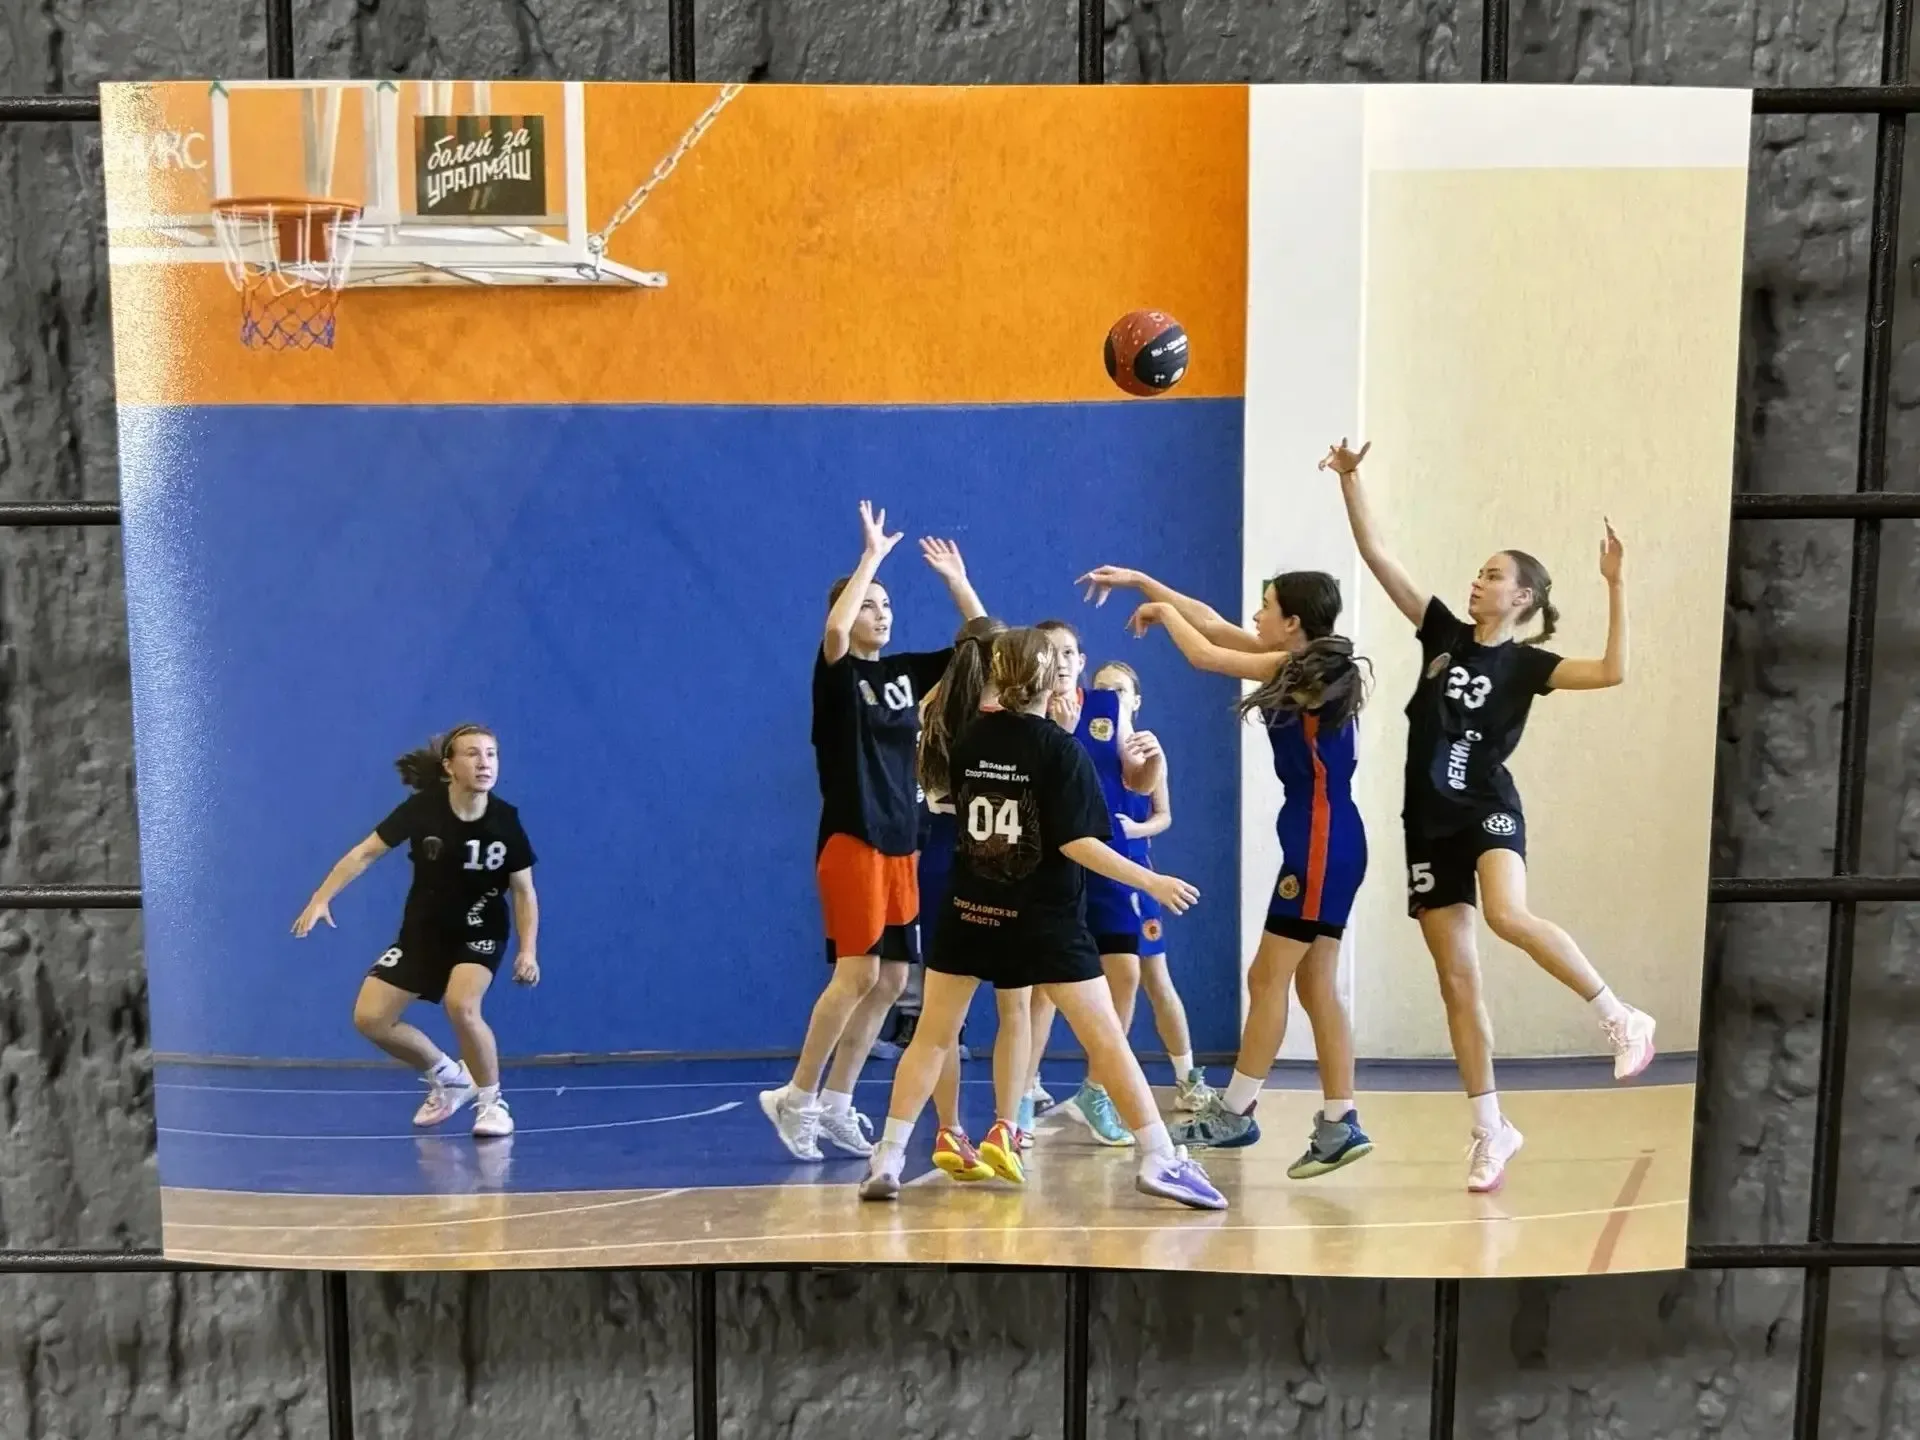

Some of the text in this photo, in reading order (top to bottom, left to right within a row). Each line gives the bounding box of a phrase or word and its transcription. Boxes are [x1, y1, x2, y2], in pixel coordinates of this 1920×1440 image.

[427, 128, 531, 170] болей за
[427, 149, 531, 208] УРАЛМАШ
[1445, 666, 1492, 709] 23
[968, 796, 1022, 844] 04
[463, 839, 507, 871] 18
